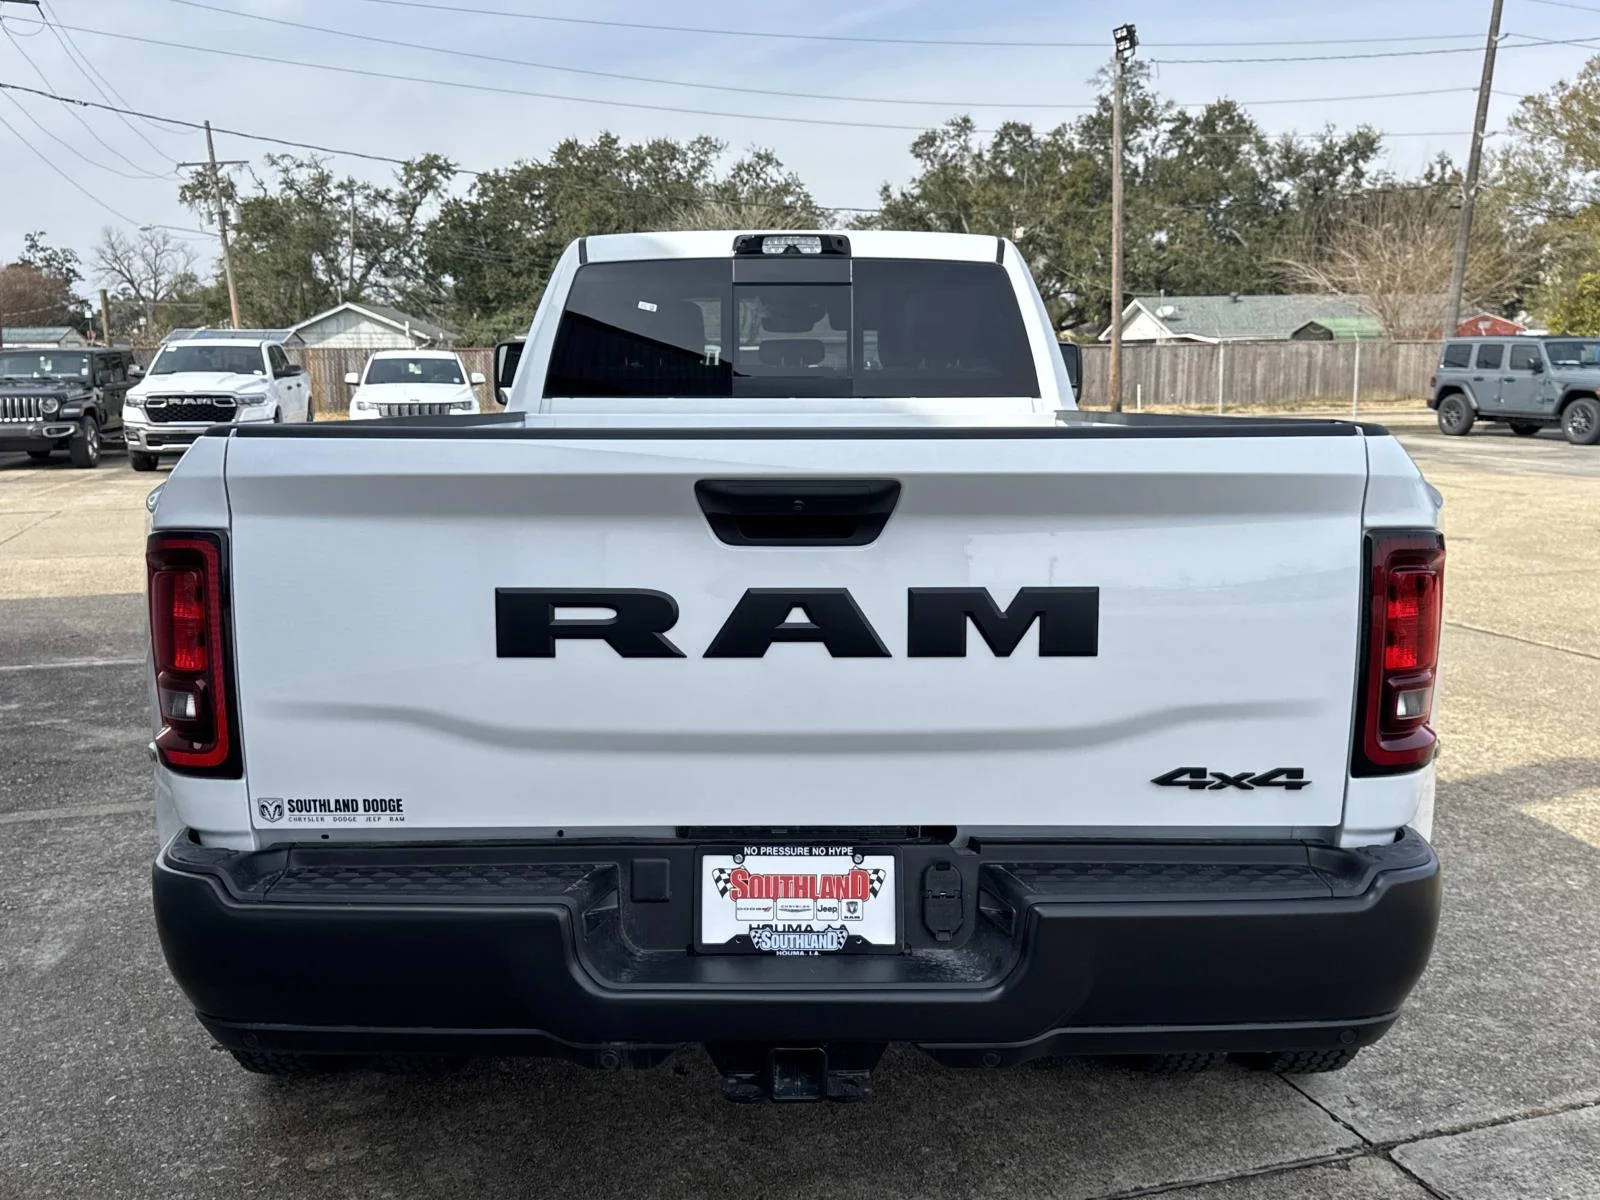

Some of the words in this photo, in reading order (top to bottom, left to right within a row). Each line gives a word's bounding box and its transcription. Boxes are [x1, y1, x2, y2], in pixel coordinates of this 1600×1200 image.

[495, 587, 1099, 659] RAM
[1151, 767, 1312, 790] 4x4
[287, 798, 358, 813] SOUTHLAND
[363, 798, 403, 813] DODGE
[744, 846, 757, 856] NO
[760, 846, 809, 856] PRESSURE
[812, 846, 826, 856] NO
[828, 847, 853, 856] HYPE
[729, 867, 871, 902] SOUTHLAND
[817, 905, 838, 914] Jeep
[761, 931, 838, 950] SOUTHLAND
